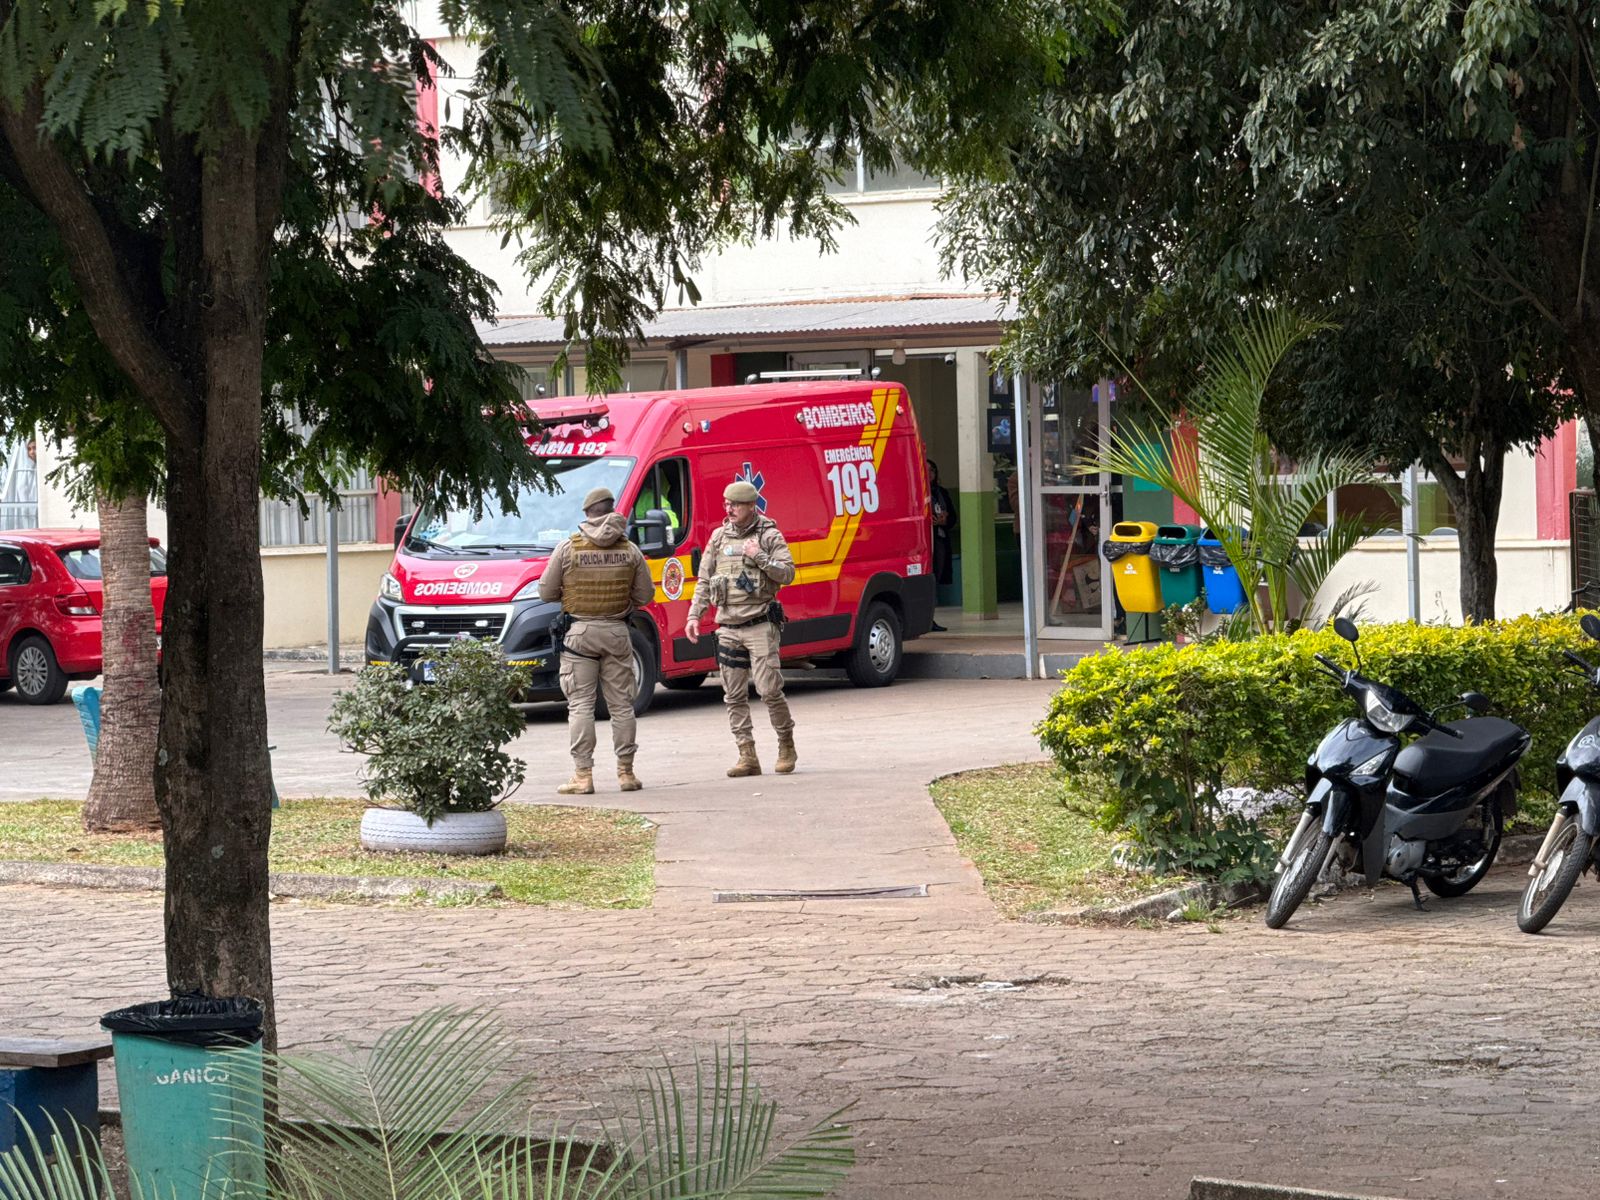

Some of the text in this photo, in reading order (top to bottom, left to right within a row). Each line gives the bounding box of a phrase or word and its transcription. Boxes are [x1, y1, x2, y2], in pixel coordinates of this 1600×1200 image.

[802, 402, 876, 430] BOMBEIROS
[577, 441, 607, 455] 193
[824, 445, 874, 464] EMERGÊNCIA
[827, 461, 879, 516] 193
[603, 553, 628, 565] MILITAR
